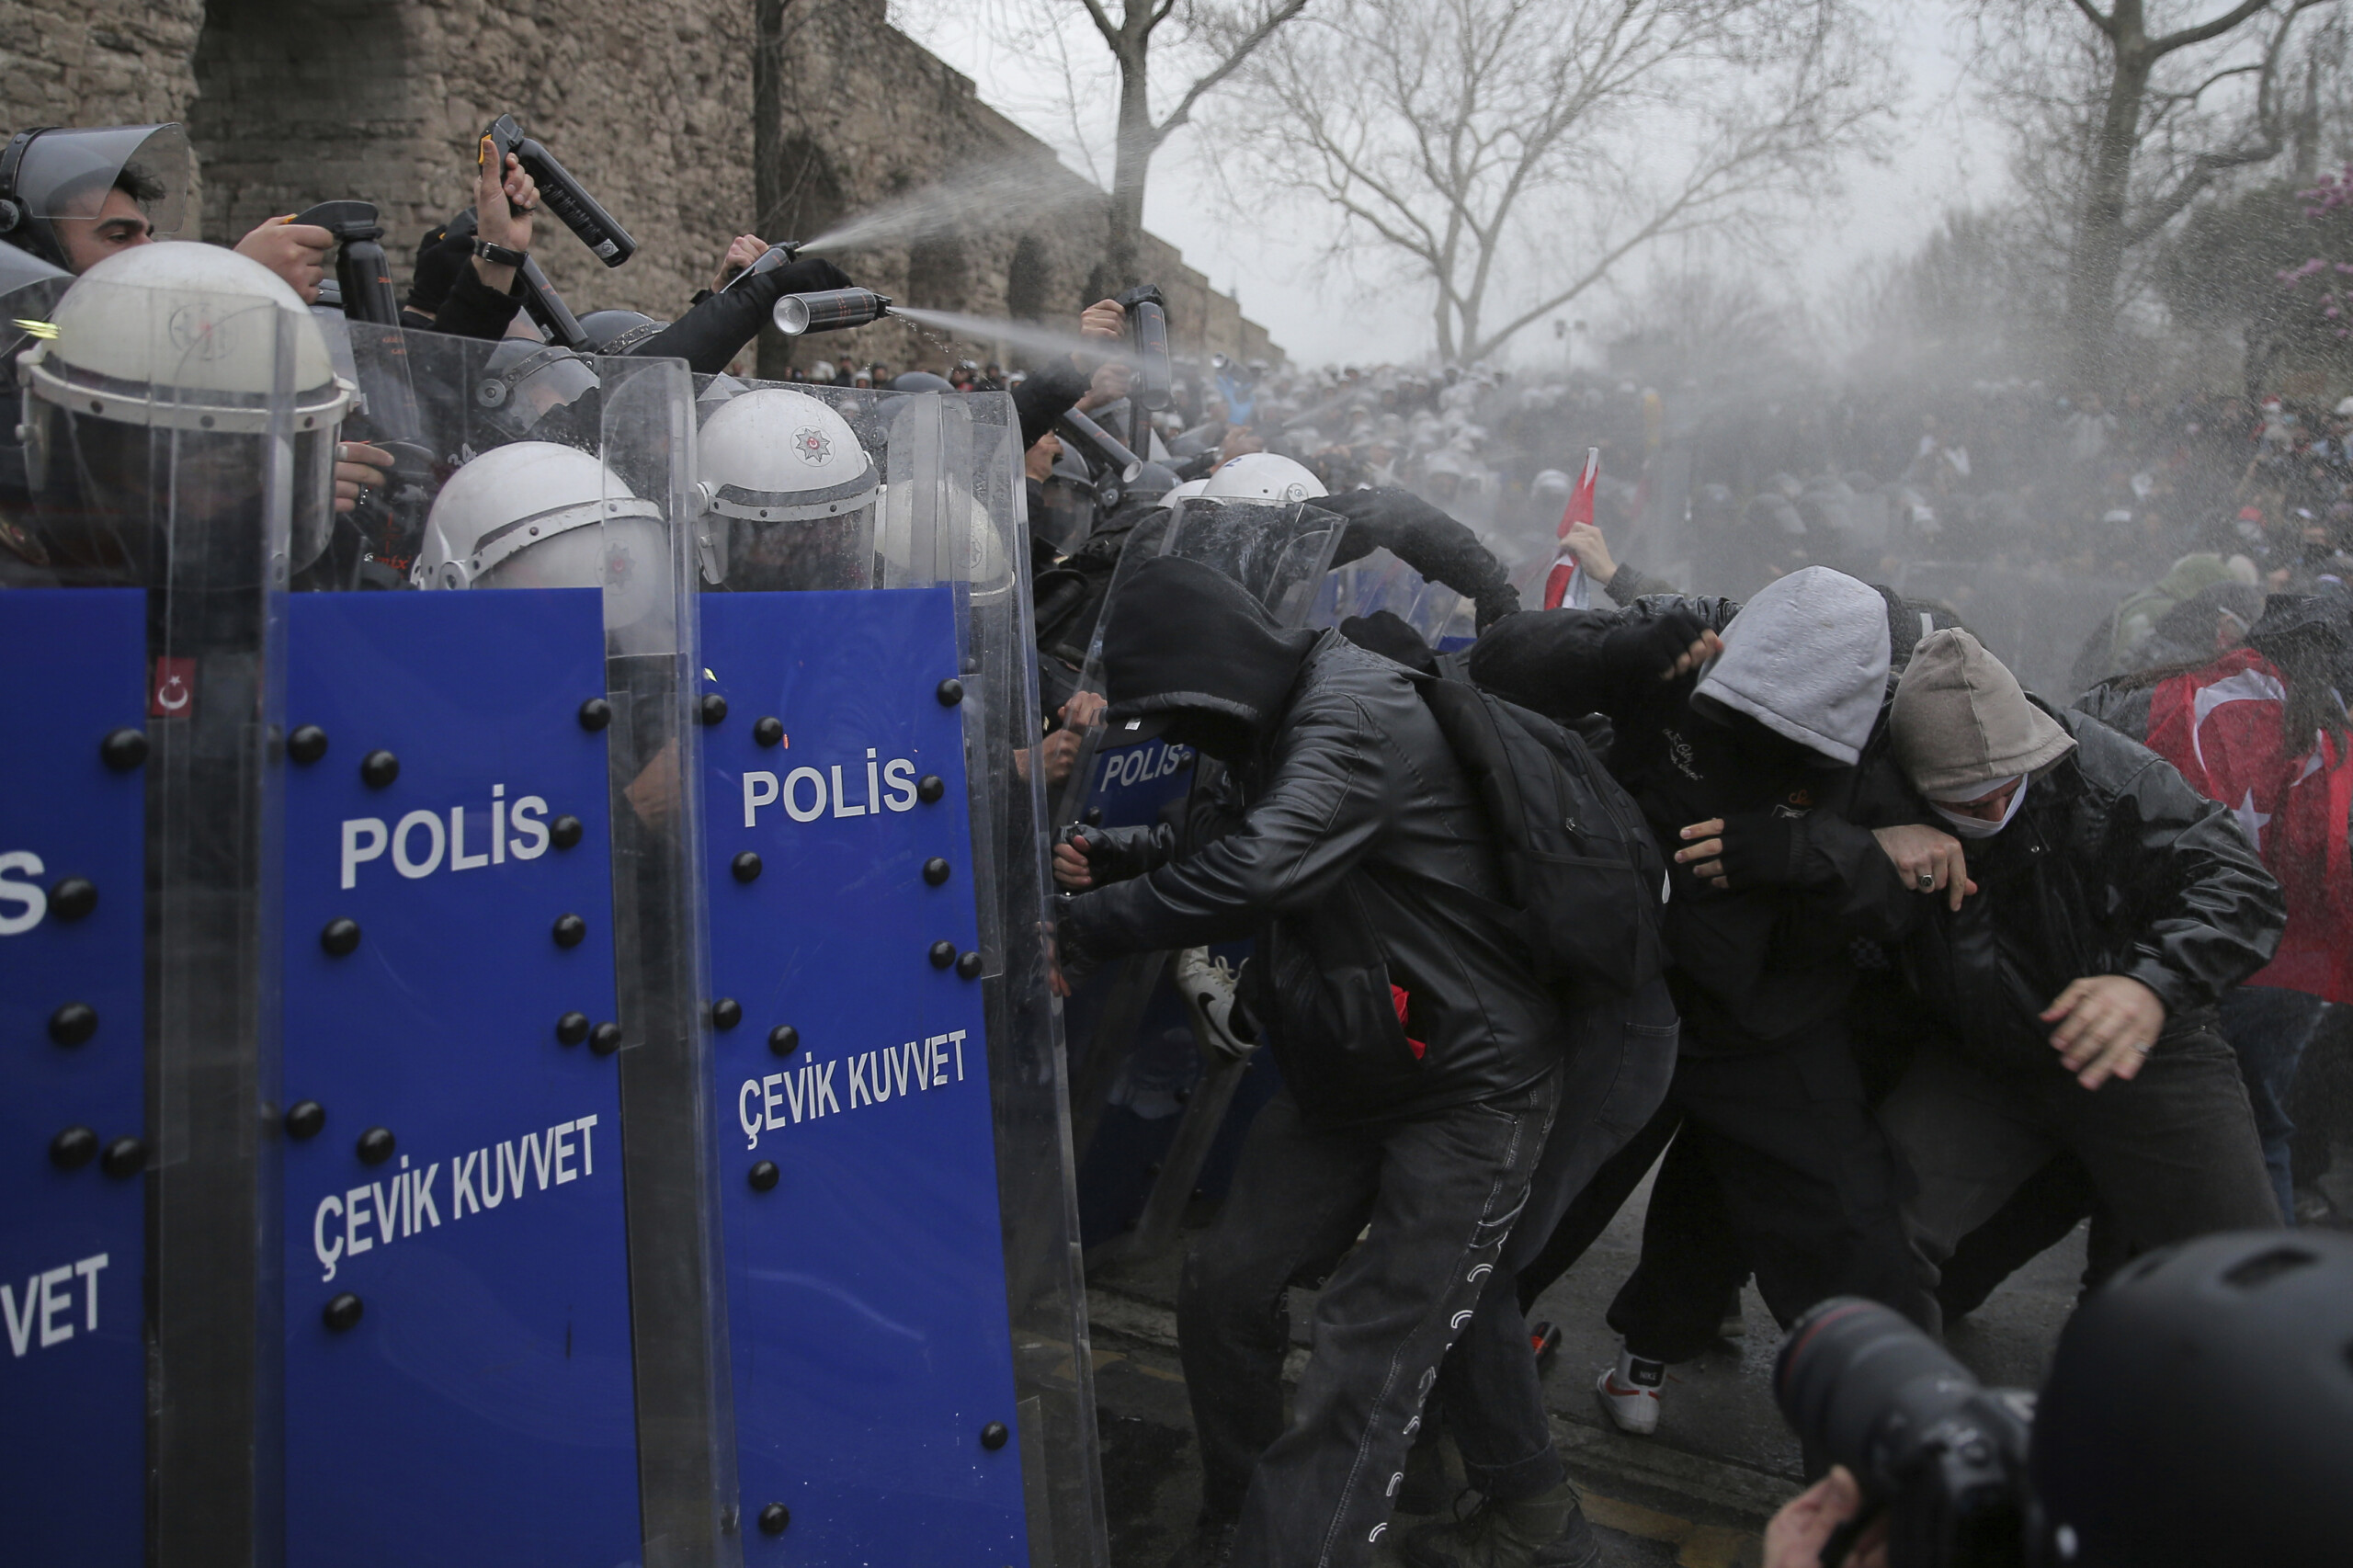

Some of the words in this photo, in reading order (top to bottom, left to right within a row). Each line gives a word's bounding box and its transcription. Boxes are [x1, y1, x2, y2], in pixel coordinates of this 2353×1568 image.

[341, 783, 550, 890] POLİS
[743, 734, 918, 828] POLİS
[739, 1051, 841, 1151] ÇEVİK
[847, 1028, 967, 1109] KUVVET
[313, 1154, 441, 1283] ÇEVİK
[452, 1113, 598, 1221] KUVVET
